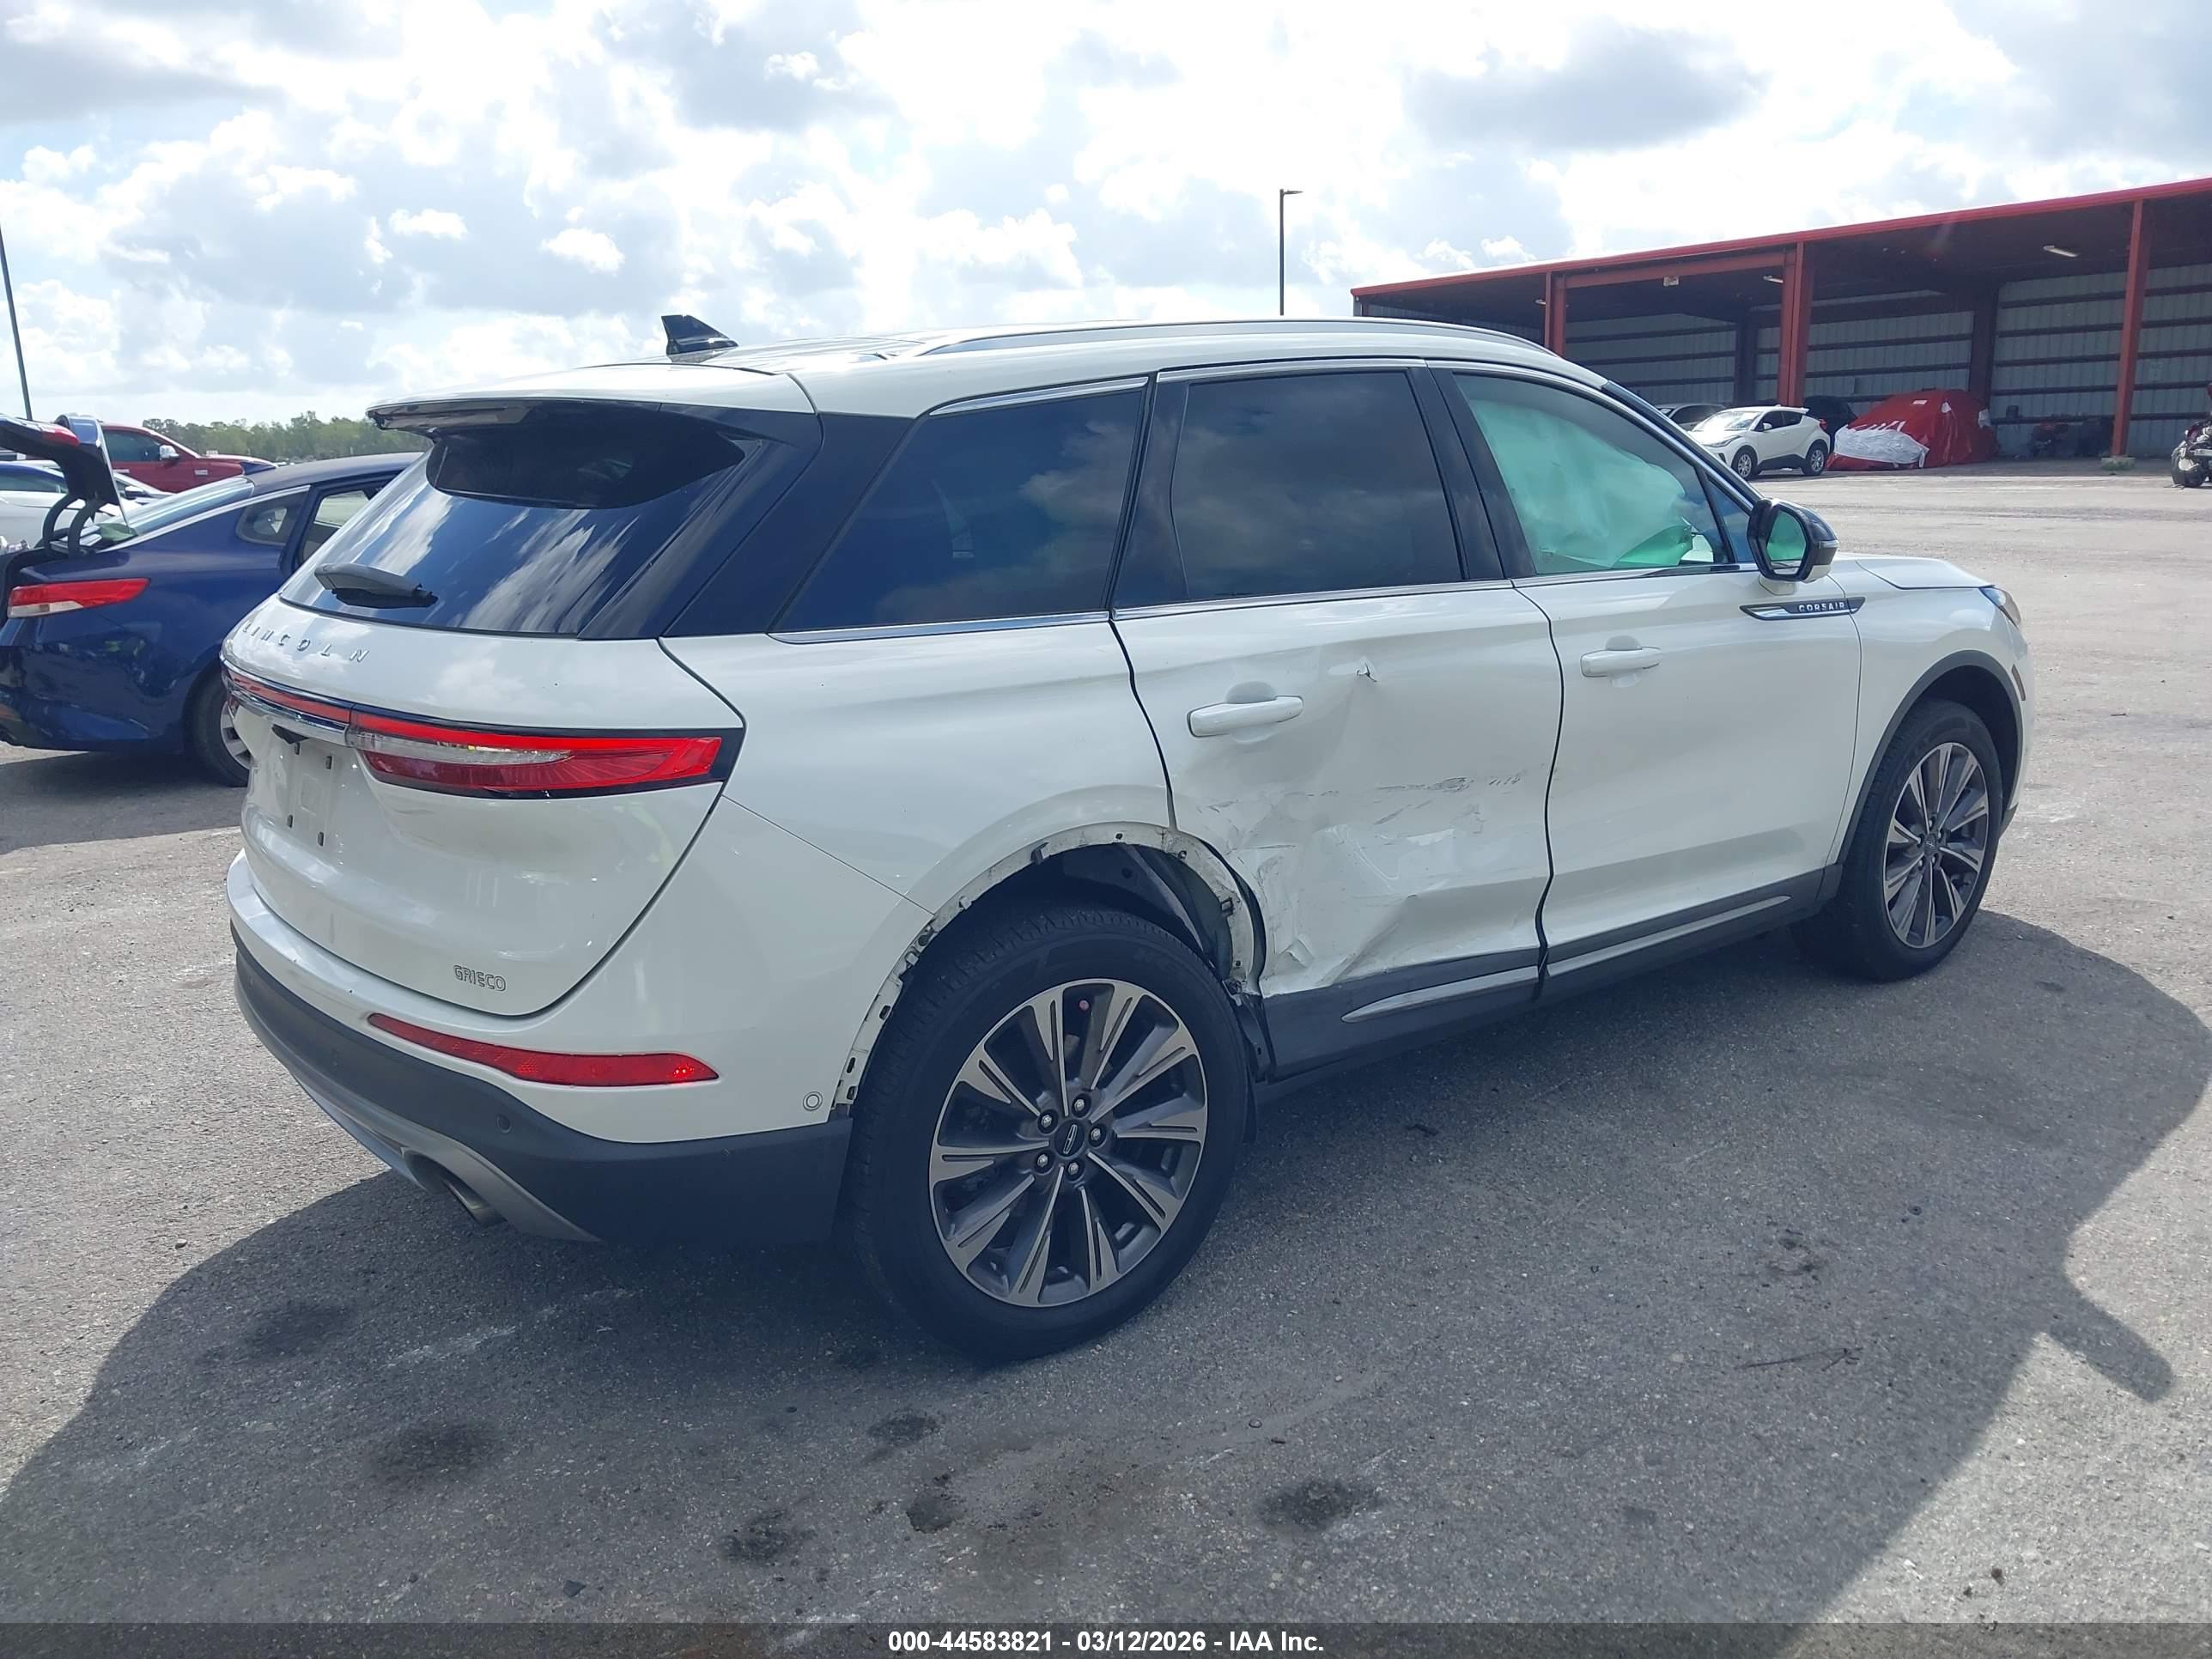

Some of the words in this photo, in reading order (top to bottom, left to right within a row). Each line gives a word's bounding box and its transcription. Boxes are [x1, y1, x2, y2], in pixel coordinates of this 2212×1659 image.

[1798, 601, 1845, 612] CORSAIR
[242, 620, 369, 663] LINCOLN
[453, 964, 507, 992] GRIECO
